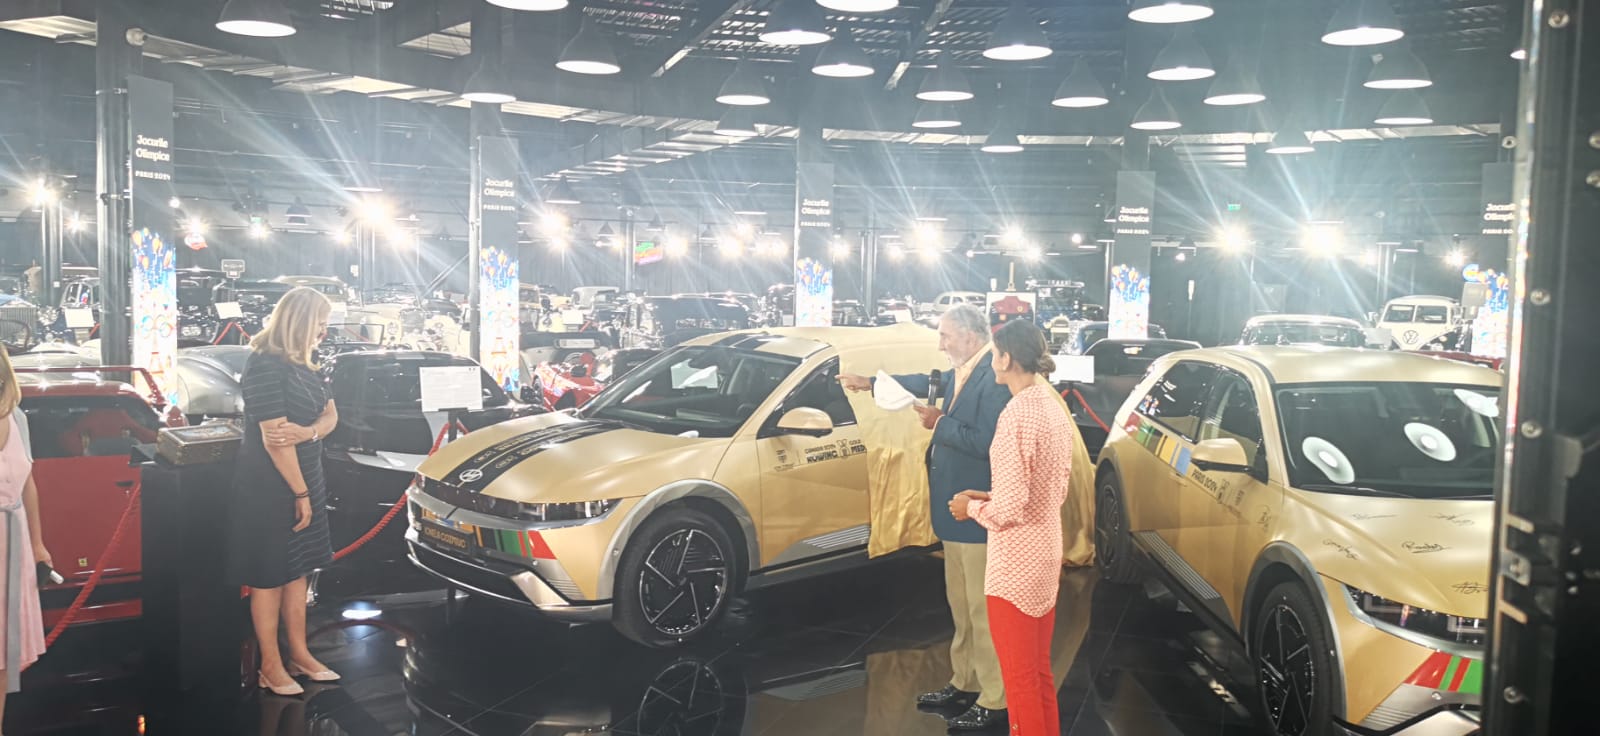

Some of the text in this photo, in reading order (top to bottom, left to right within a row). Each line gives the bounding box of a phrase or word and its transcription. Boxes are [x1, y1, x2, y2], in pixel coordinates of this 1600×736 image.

[136, 134, 169, 148] Jocurile
[135, 147, 170, 162] Olimpice
[135, 170, 153, 178] PARIS
[485, 178, 513, 188] Jocurile
[484, 188, 515, 198] Olimpice
[802, 198, 829, 207] Jocurile
[801, 207, 831, 216] Olimpice
[1119, 206, 1149, 215] Jocurile
[1118, 214, 1150, 224] Olimpice
